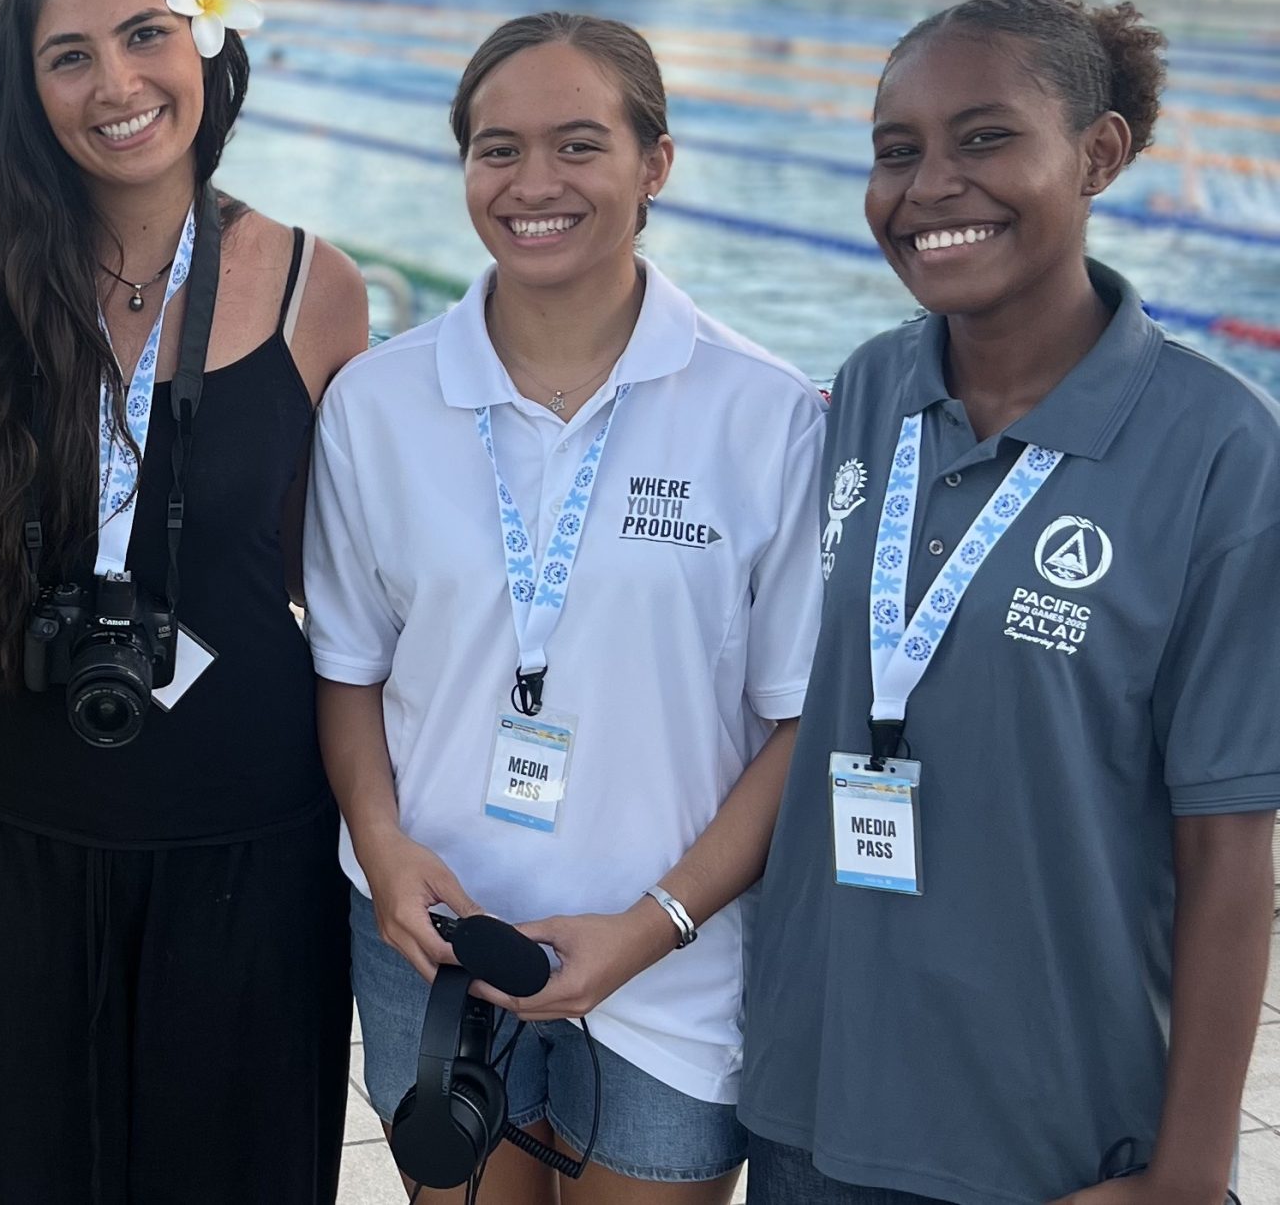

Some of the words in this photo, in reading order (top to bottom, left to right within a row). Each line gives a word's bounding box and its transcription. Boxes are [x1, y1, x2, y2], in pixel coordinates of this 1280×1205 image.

[630, 477, 691, 499] WHERE
[627, 496, 683, 519] YOUTH
[622, 516, 707, 544] PRODUCE
[1010, 601, 1031, 614] MINI
[1031, 607, 1065, 623] GAMES
[1065, 617, 1087, 630] 2025
[1013, 587, 1091, 621] PACIFIC
[99, 617, 130, 626] Canon
[1006, 610, 1085, 643] PALAU
[508, 756, 549, 781] MEDIA
[509, 778, 541, 800] PASS
[851, 816, 897, 837] MEDIA
[857, 839, 893, 859] PASS
